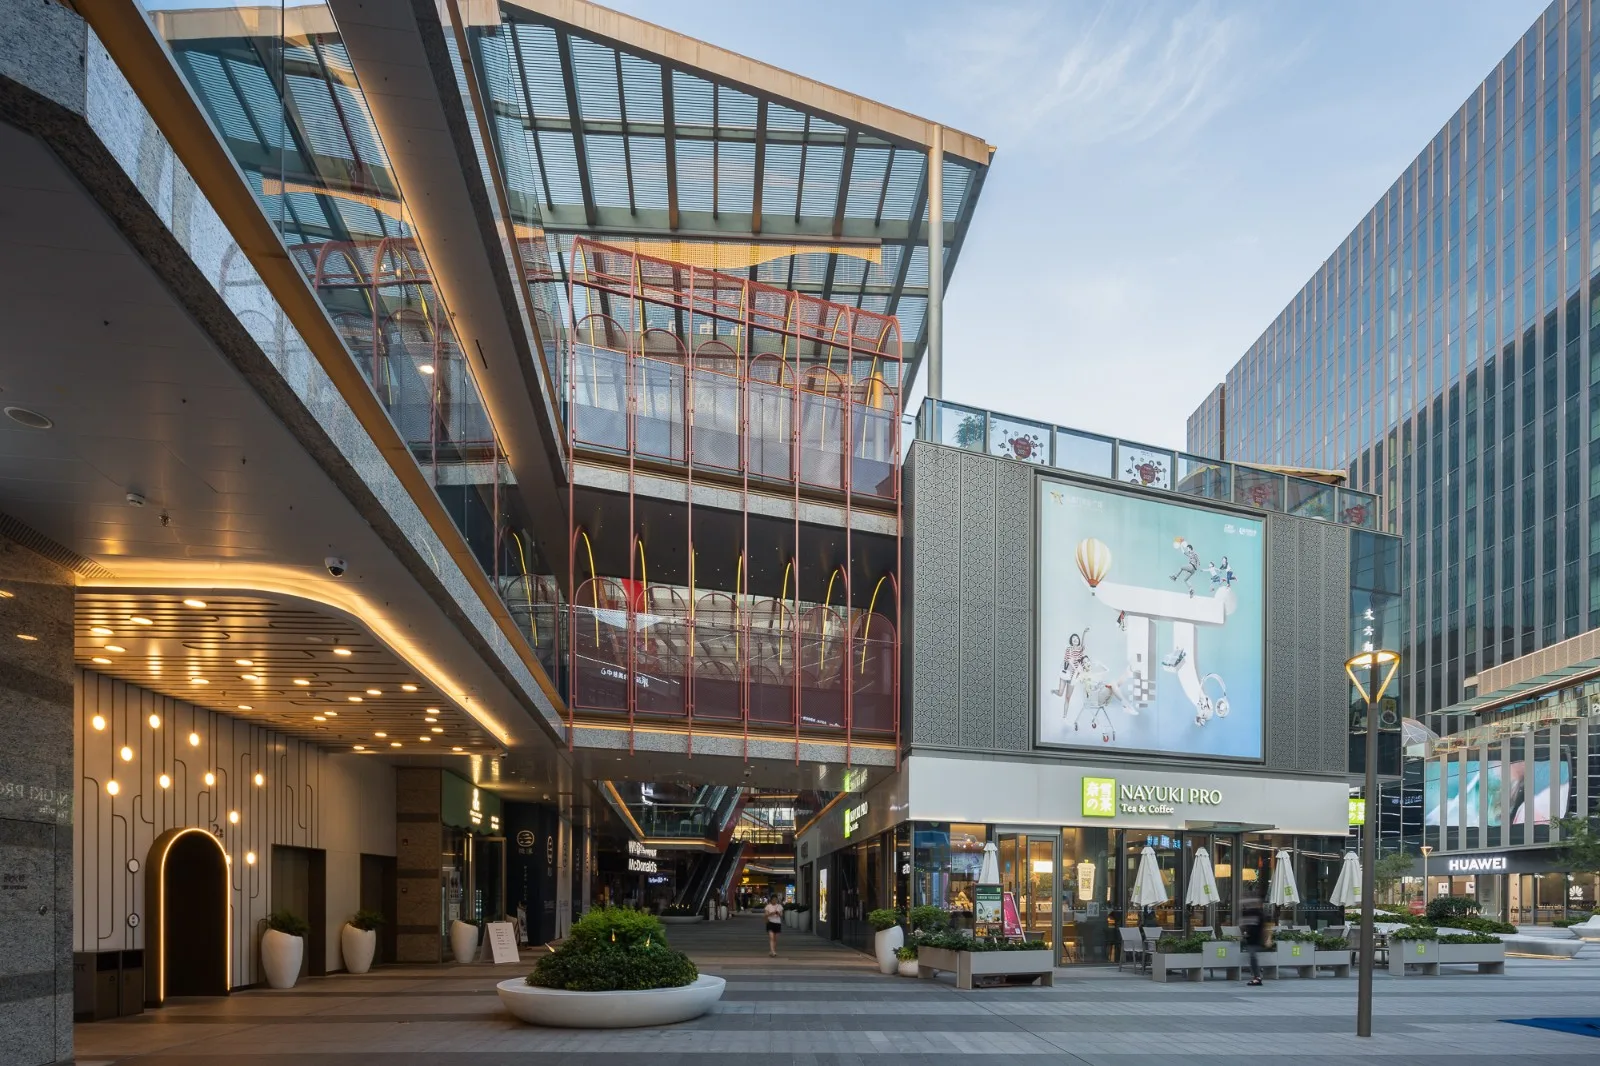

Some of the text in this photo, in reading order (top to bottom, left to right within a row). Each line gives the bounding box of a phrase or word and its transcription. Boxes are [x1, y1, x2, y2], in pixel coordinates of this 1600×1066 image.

[1119, 784, 1223, 806] NAYUKI PRO
[1121, 803, 1174, 815] Tea & Coffee
[628, 858, 658, 873] McDonald's
[1449, 857, 1507, 871] HUAWEI
